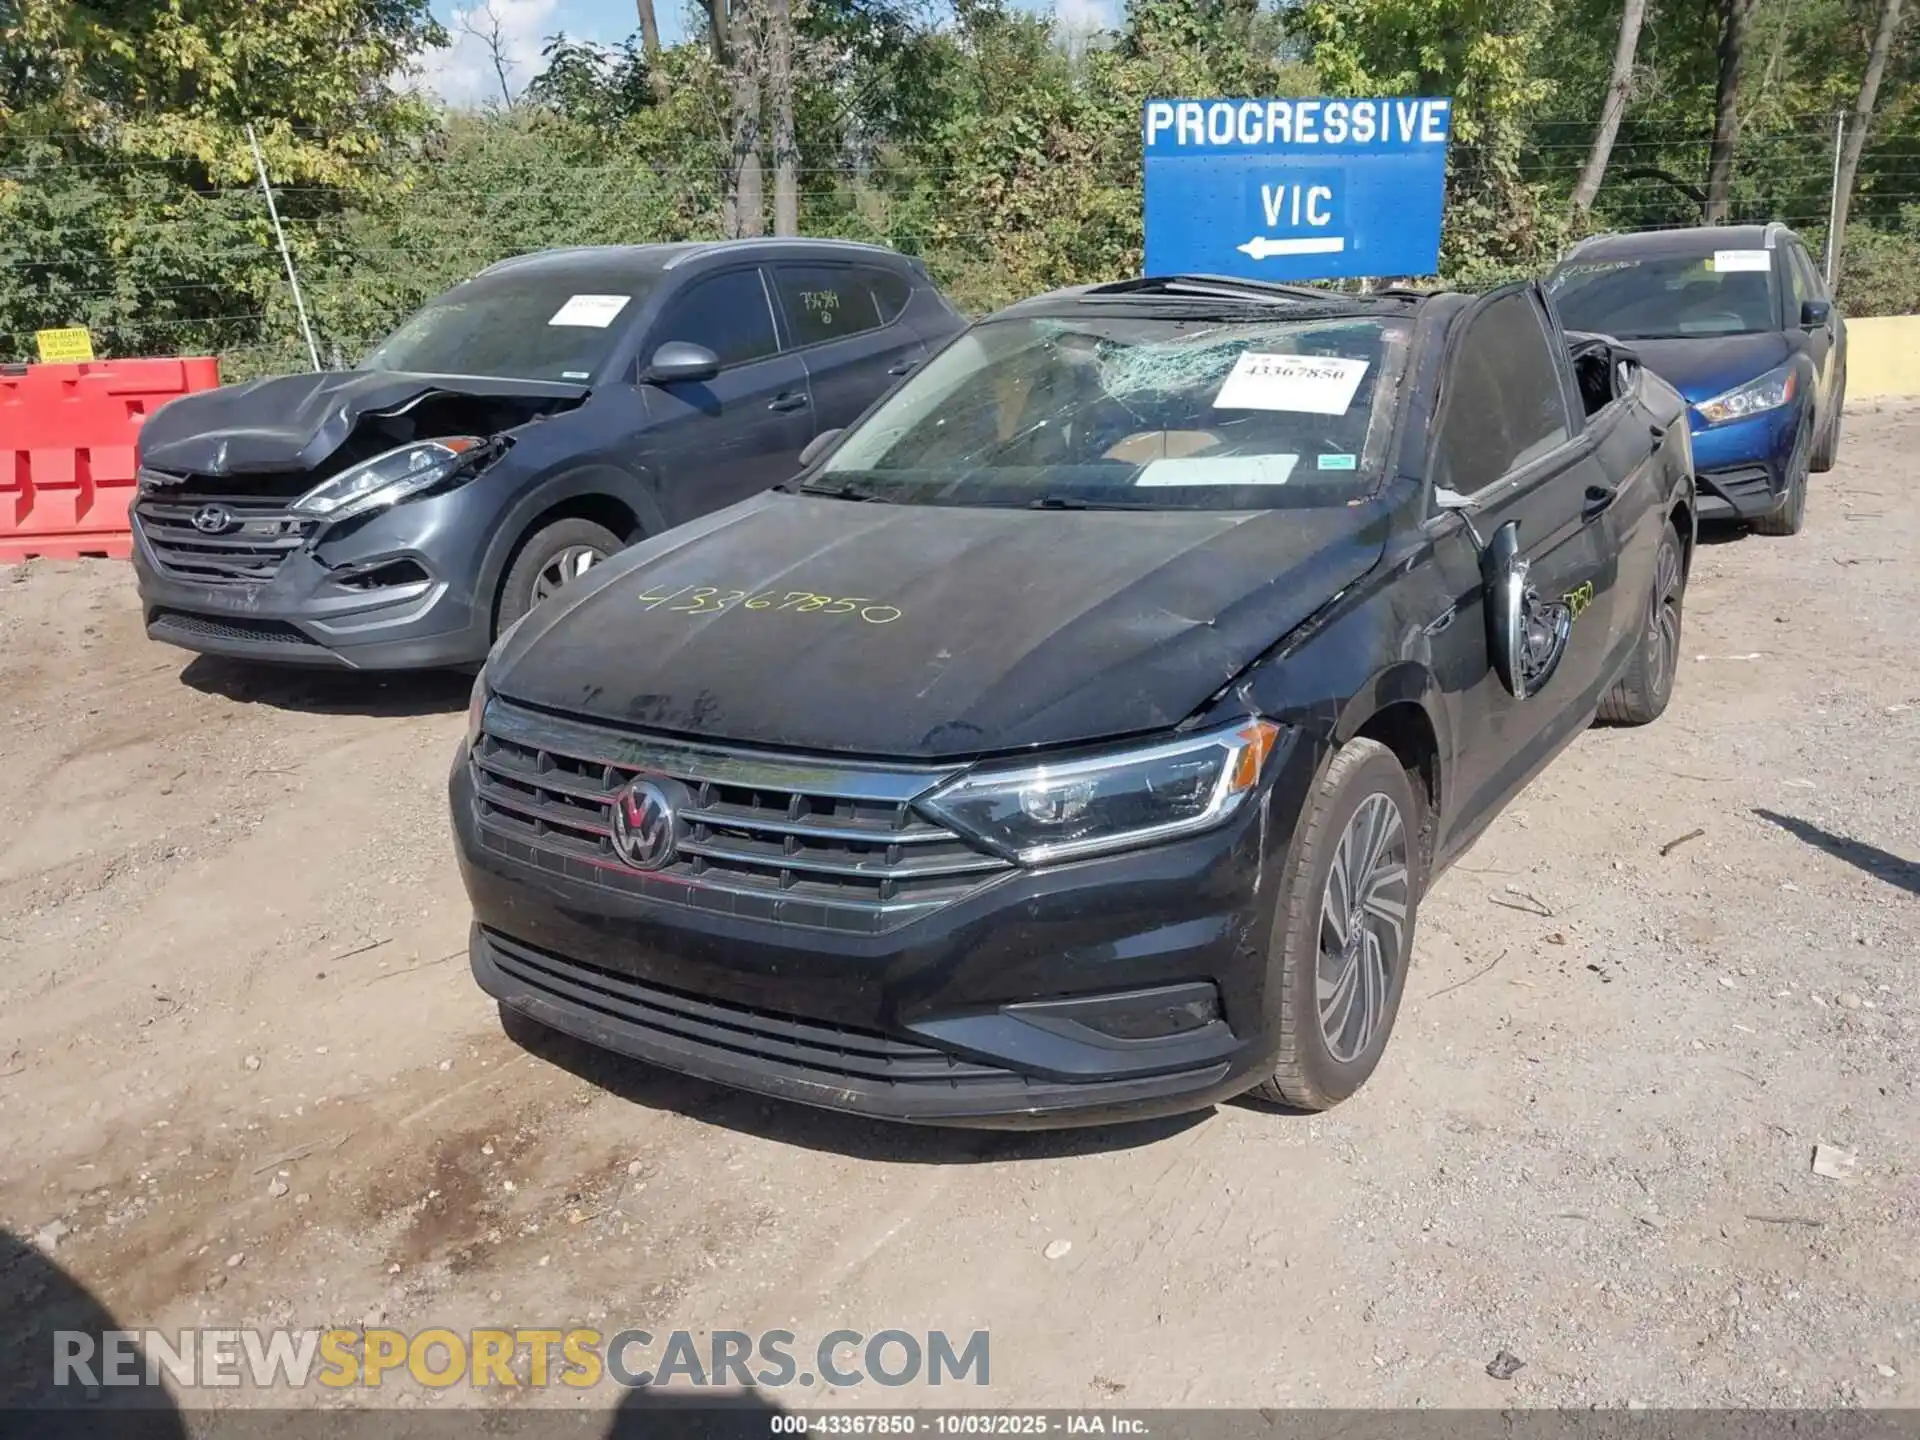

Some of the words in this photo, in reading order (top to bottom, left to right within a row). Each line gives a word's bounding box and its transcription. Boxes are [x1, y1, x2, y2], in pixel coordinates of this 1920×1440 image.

[1147, 101, 1448, 145] PROGRESSIVE
[1261, 185, 1332, 226] VIC
[1244, 364, 1346, 380] 43367850
[638, 584, 901, 623] 43367850
